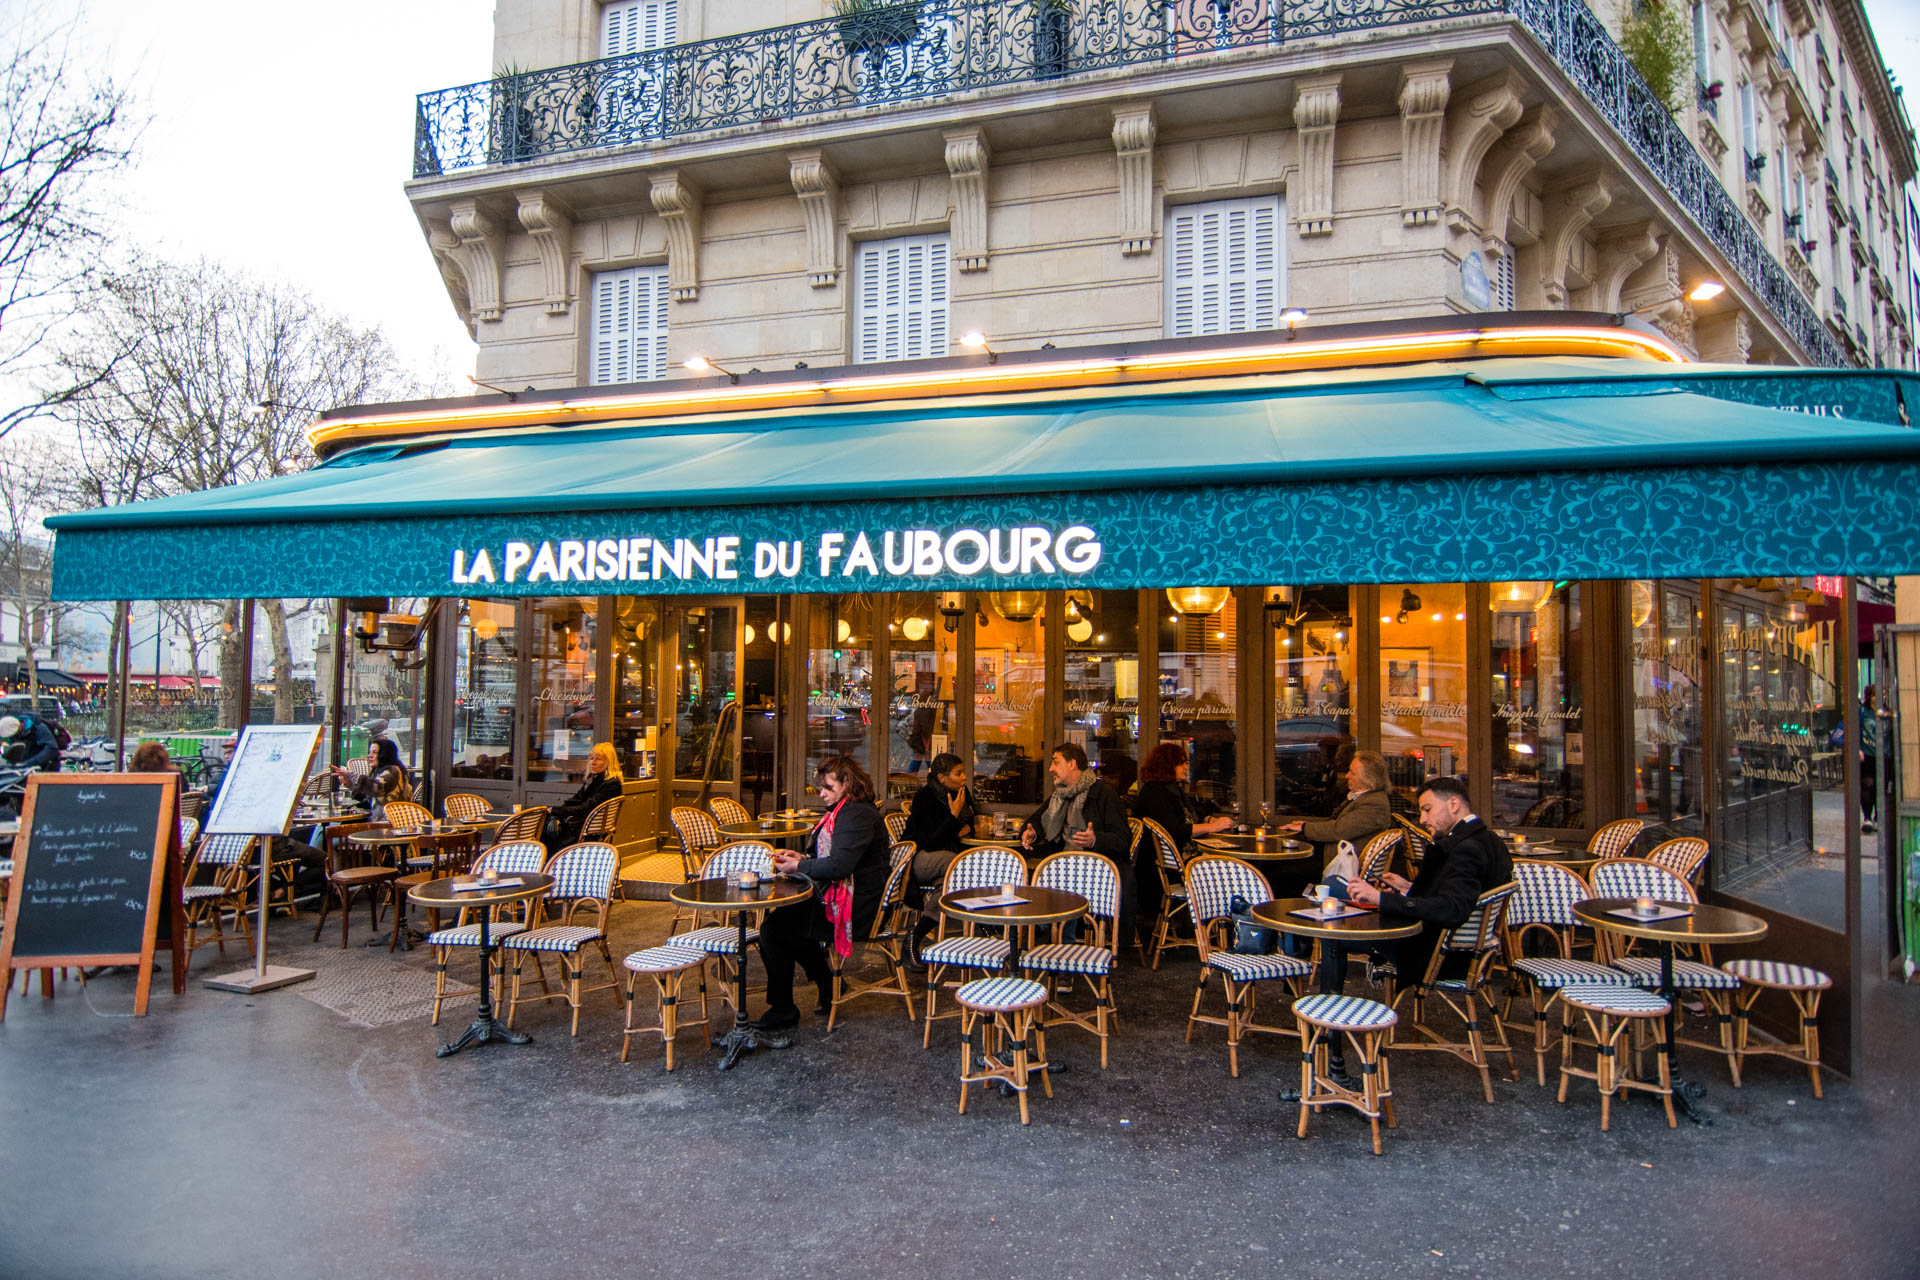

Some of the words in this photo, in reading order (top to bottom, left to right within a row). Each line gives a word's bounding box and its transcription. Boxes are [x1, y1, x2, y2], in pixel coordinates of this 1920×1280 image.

[453, 549, 494, 583] LA
[505, 536, 739, 582] PARISIENNE
[755, 541, 802, 578] DU
[818, 526, 1101, 577] FAUBOURG
[533, 687, 594, 705] Cheeseburger
[911, 693, 945, 709] Bobun
[1161, 701, 1195, 720] Croque
[1195, 703, 1237, 720] parisien
[1320, 701, 1356, 722] Tapas
[1381, 700, 1432, 717] Planche
[1432, 702, 1465, 717] mixte
[1492, 703, 1534, 725] Nuggets
[1541, 706, 1581, 725] poulet
